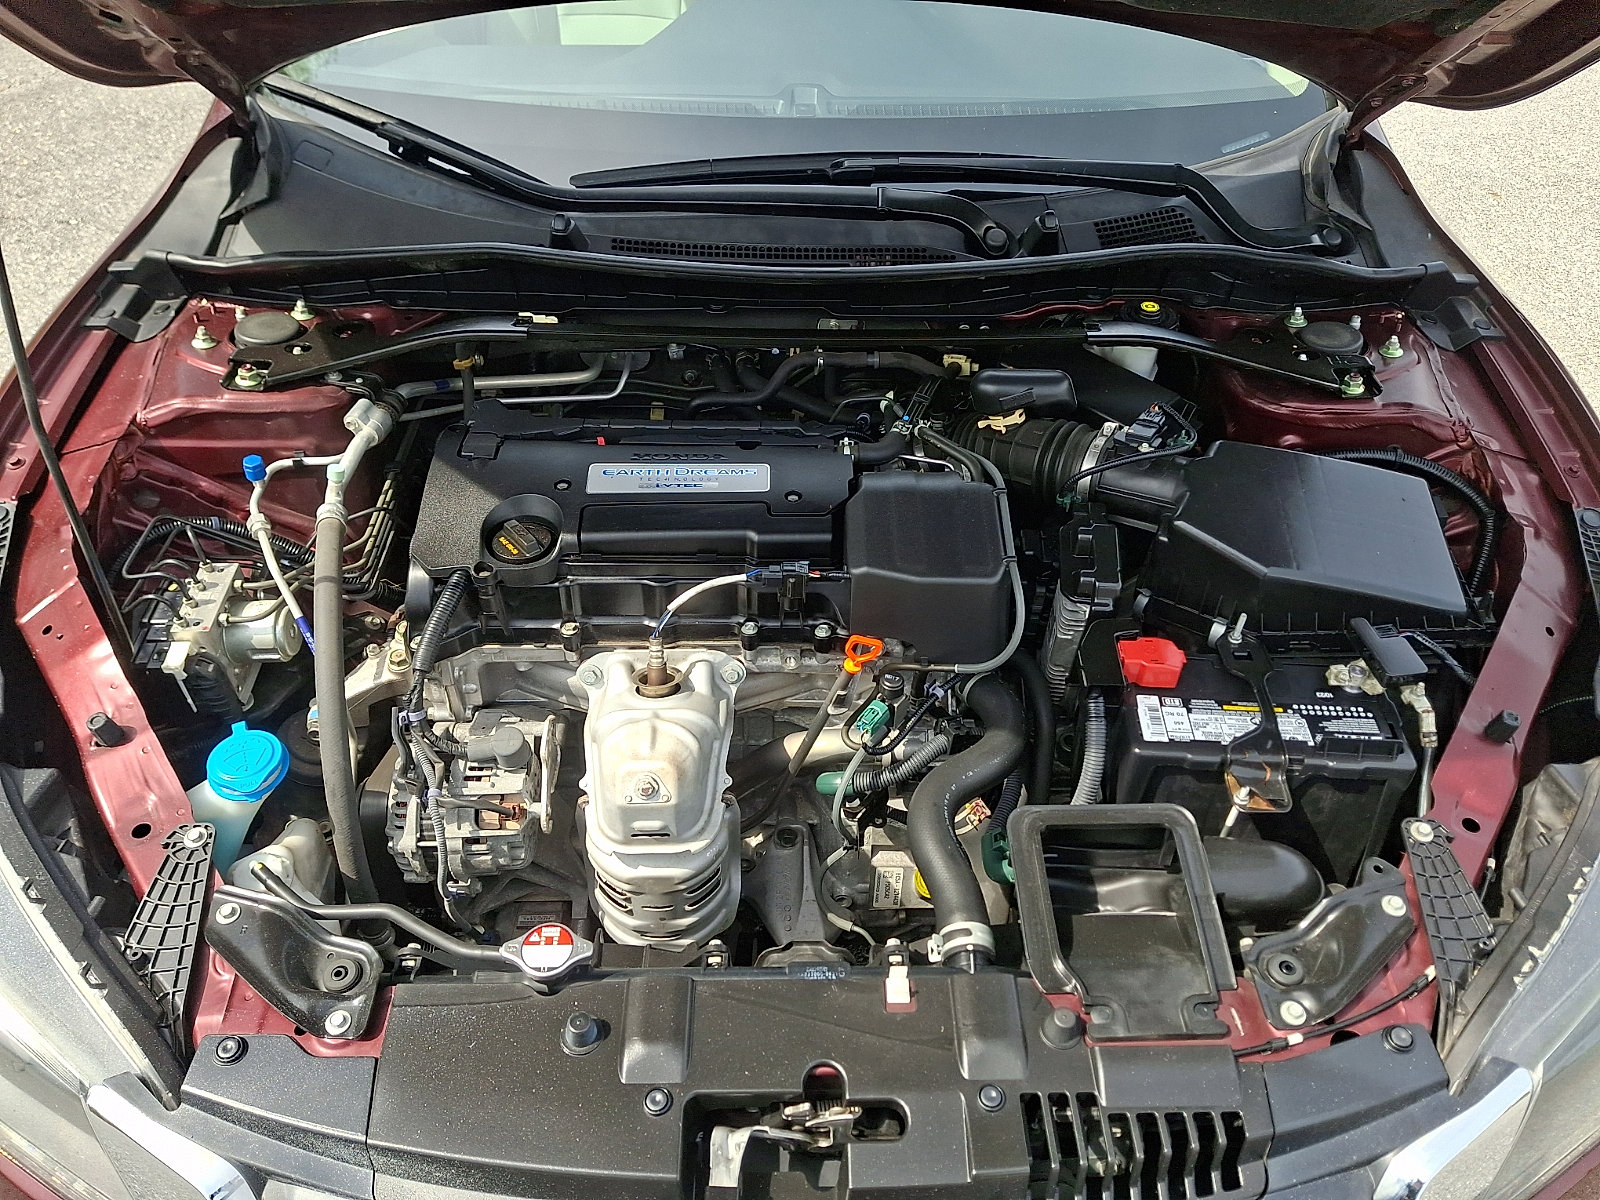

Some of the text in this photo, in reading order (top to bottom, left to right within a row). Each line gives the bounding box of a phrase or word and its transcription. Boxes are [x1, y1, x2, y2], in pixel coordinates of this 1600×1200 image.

[630, 452, 729, 461] HONDA
[602, 467, 758, 477] EARTH DREAMS
